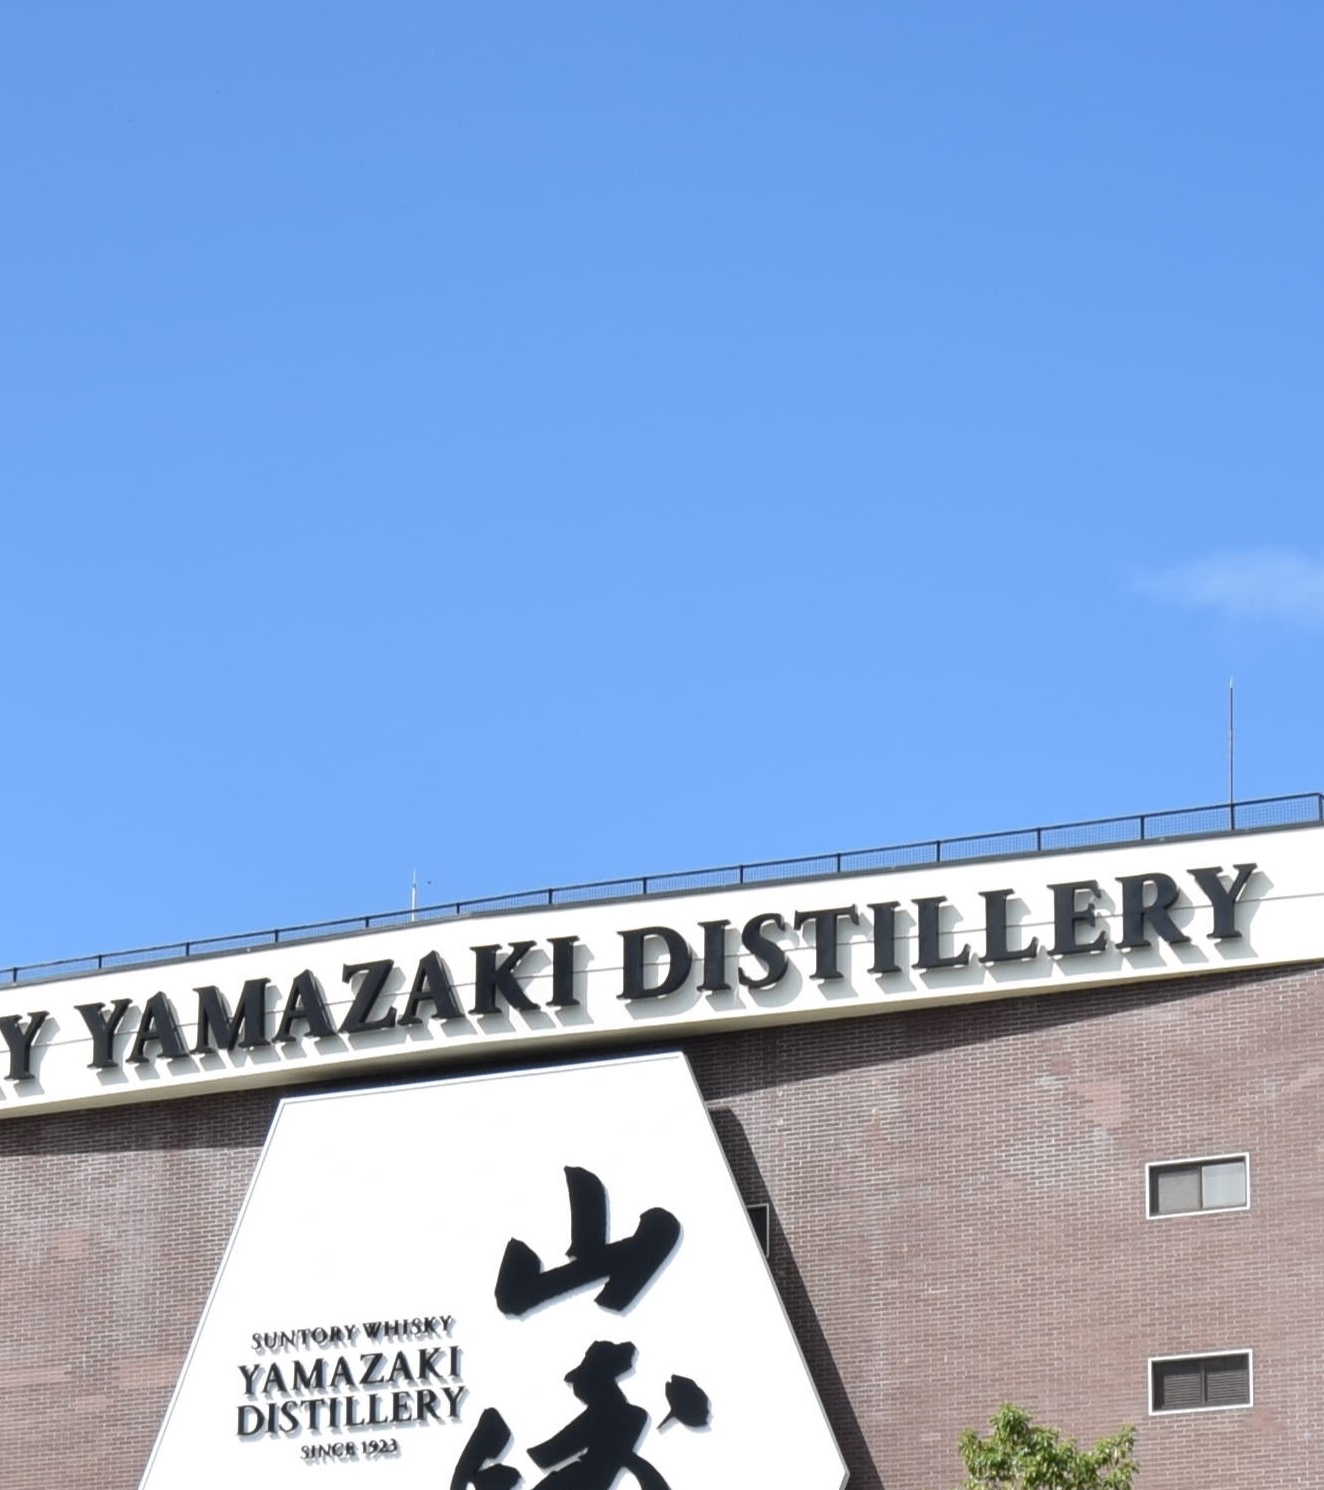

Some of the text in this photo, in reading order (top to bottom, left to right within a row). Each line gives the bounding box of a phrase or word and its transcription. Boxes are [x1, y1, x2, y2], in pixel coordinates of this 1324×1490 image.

[74, 934, 580, 1070] YAMAZAKI
[616, 862, 1258, 1001] DISTILLERY
[251, 1315, 452, 1350] SUNTORY WHISKY
[237, 1345, 460, 1396] YAMAZAKI
[236, 1386, 466, 1436] DISTILLERY
[300, 1438, 399, 1460] SINCE 1923
